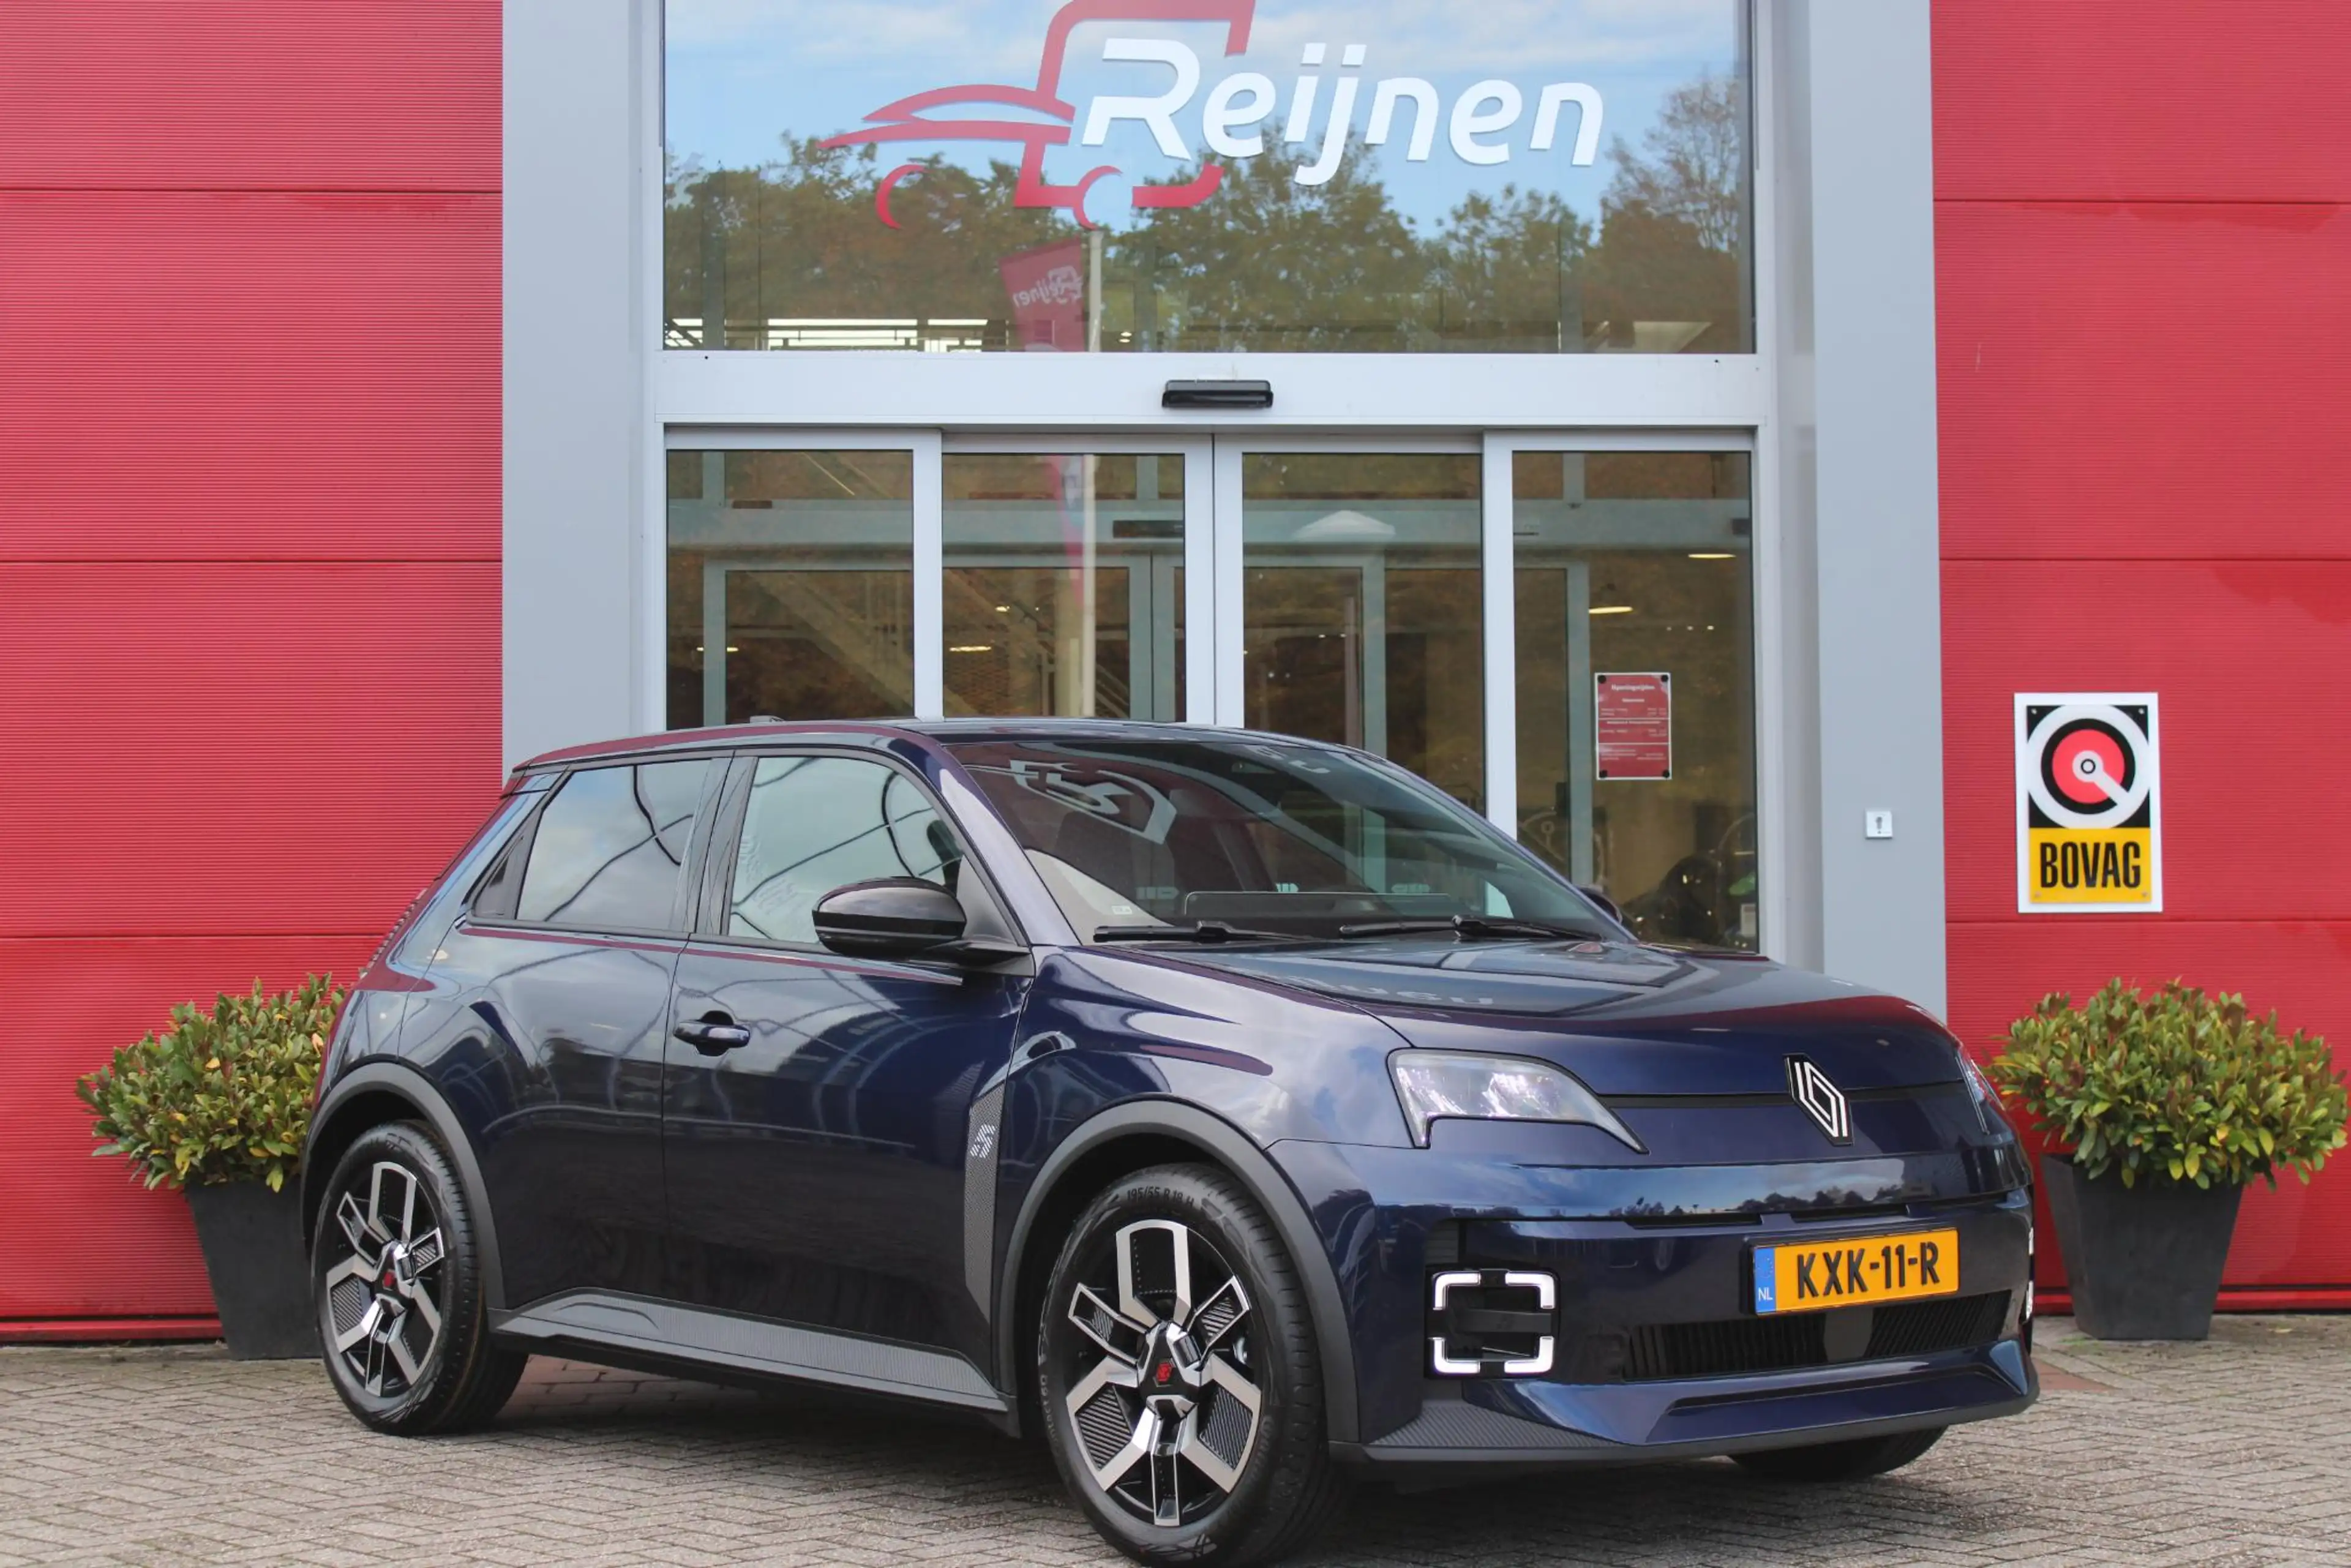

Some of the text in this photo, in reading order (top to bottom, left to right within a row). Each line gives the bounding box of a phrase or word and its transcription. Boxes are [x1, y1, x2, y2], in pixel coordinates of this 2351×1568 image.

[1081, 37, 1604, 186] Reijnen
[2039, 841, 2141, 890] BOVAG
[1758, 1286, 1773, 1301] NL
[1797, 1241, 1940, 1300] KXK-11-R
